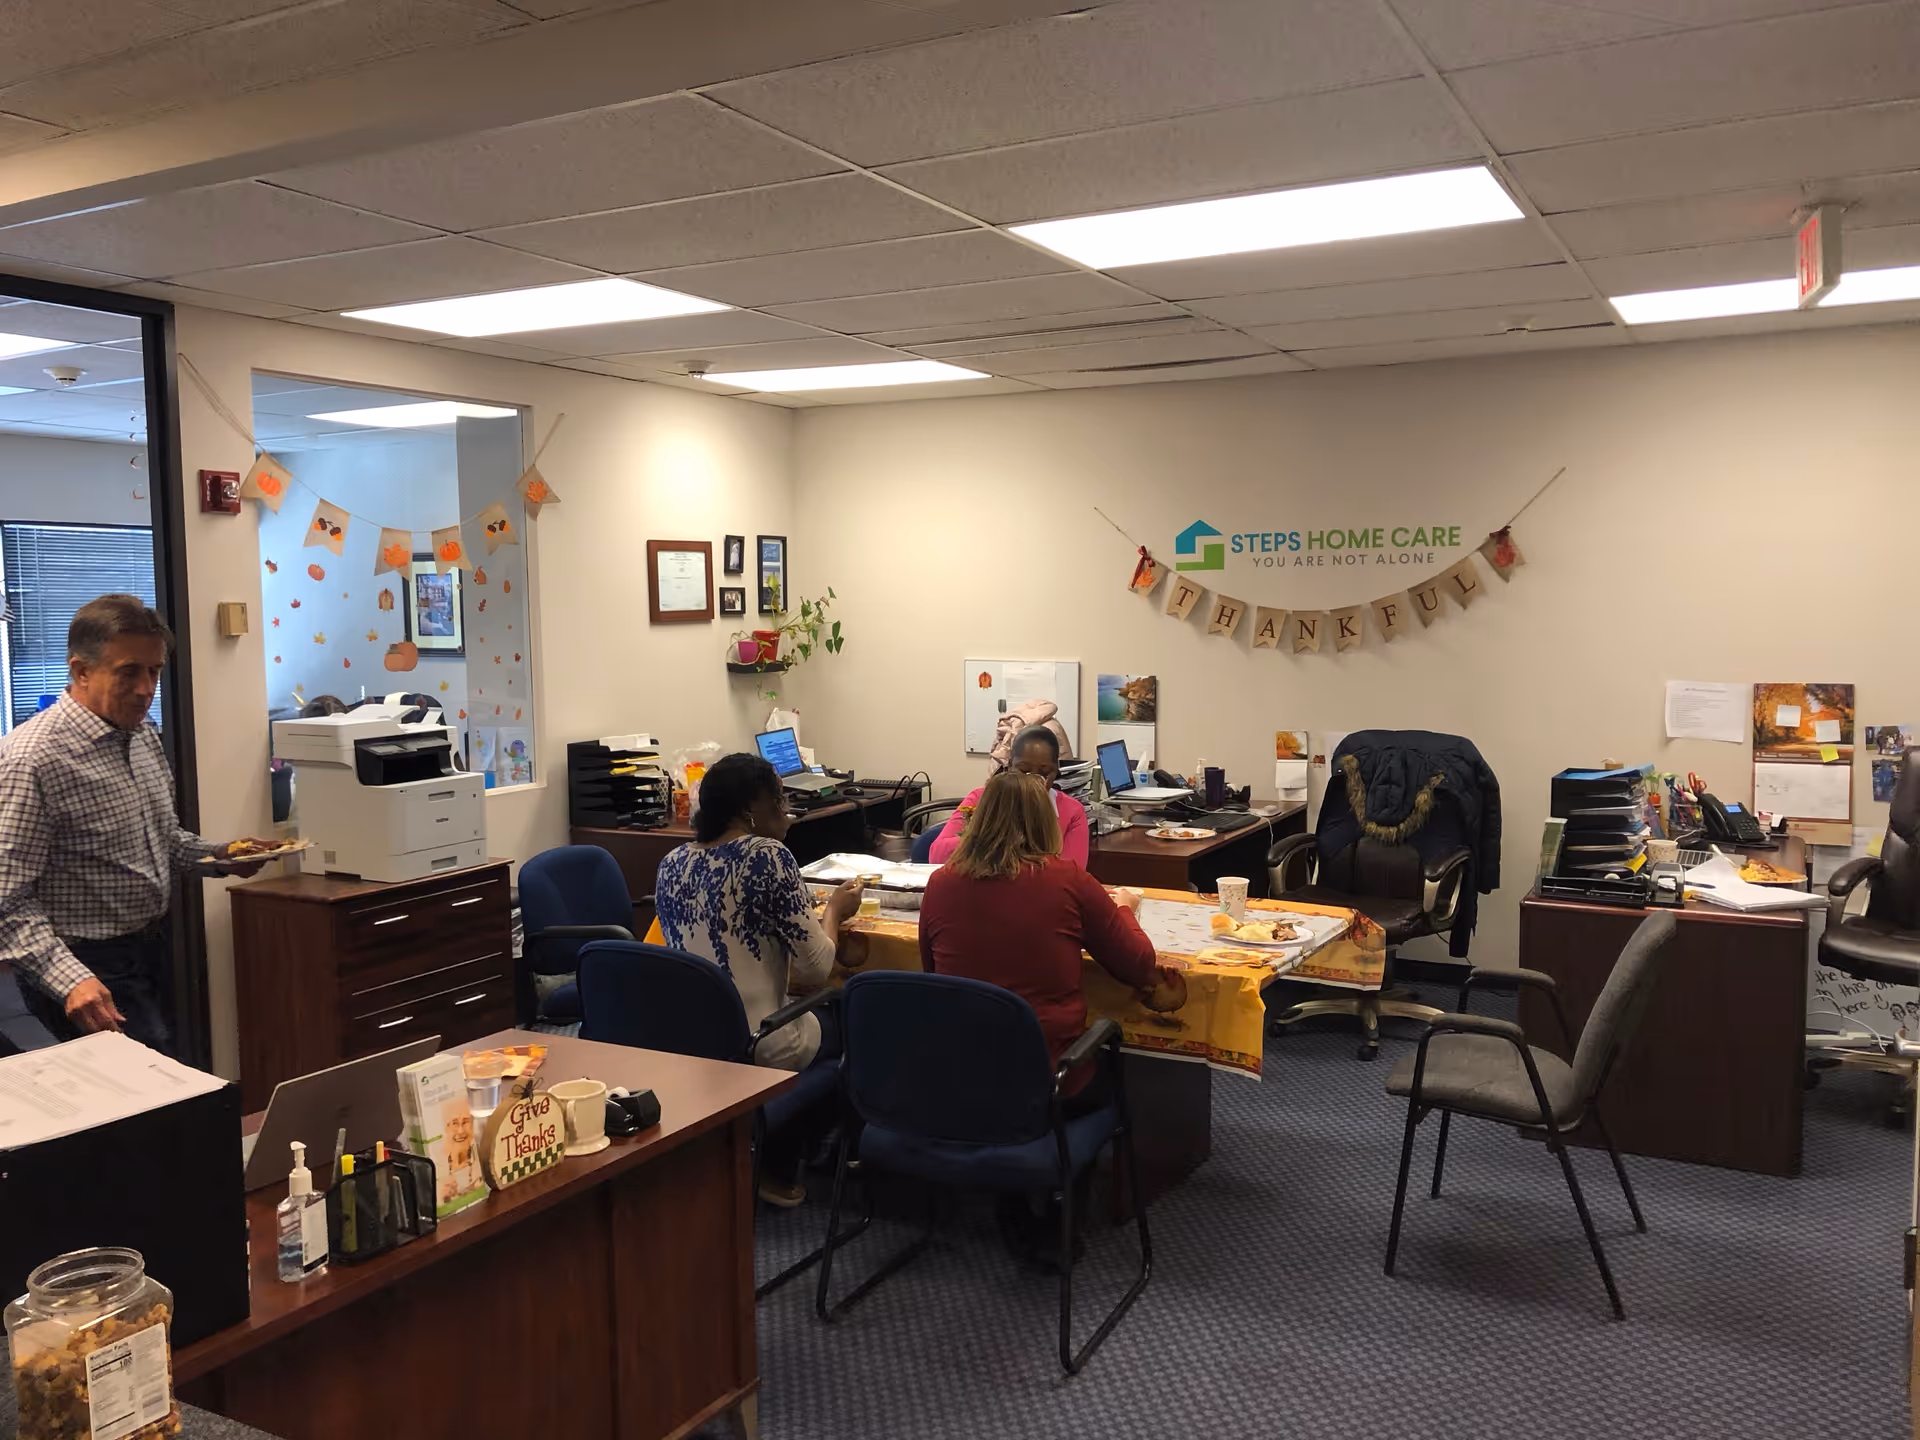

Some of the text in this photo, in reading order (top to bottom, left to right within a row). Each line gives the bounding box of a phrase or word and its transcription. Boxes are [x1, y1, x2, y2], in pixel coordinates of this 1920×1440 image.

[1231, 525, 1462, 554] STEPS HOME CARE
[1252, 552, 1435, 568] YOU ARE NOT ALONE
[1175, 571, 1477, 641] THANKFUL
[510, 1095, 551, 1134] Give
[501, 1123, 556, 1162] Thanks
